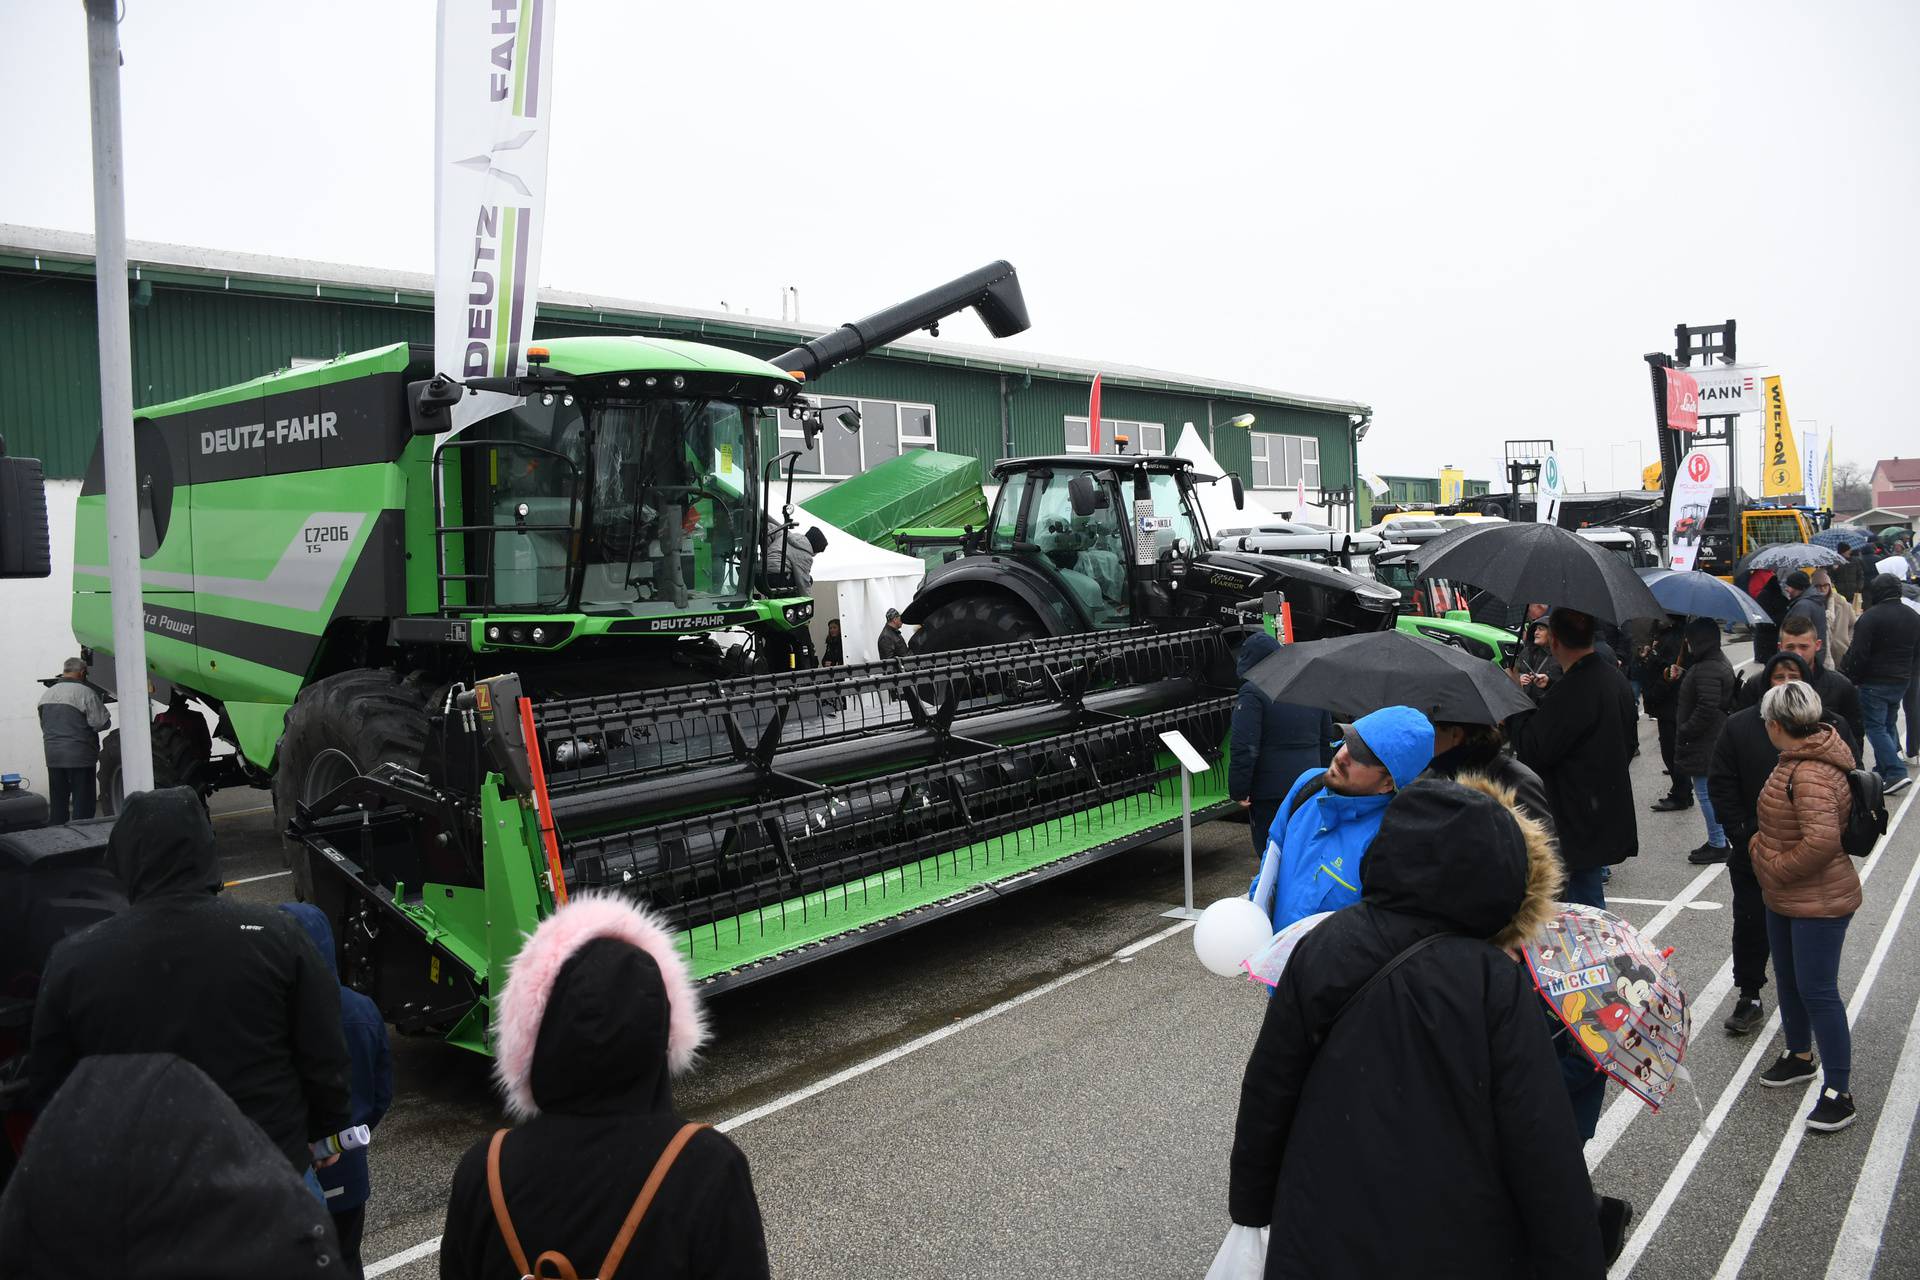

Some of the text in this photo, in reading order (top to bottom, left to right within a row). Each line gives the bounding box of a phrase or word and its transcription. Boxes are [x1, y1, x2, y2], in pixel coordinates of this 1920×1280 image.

[462, 204, 499, 378] DEUTZ
[200, 411, 338, 455] DEUTZ-FAHR
[1771, 384, 1787, 466] WIELTON
[304, 525, 349, 543] C7206
[306, 544, 322, 554] TS
[1210, 577, 1245, 590] WARRIOR
[159, 615, 195, 636] Power
[650, 615, 725, 631] DEUTZ-FAHR
[1551, 967, 1606, 993] MICKEY
